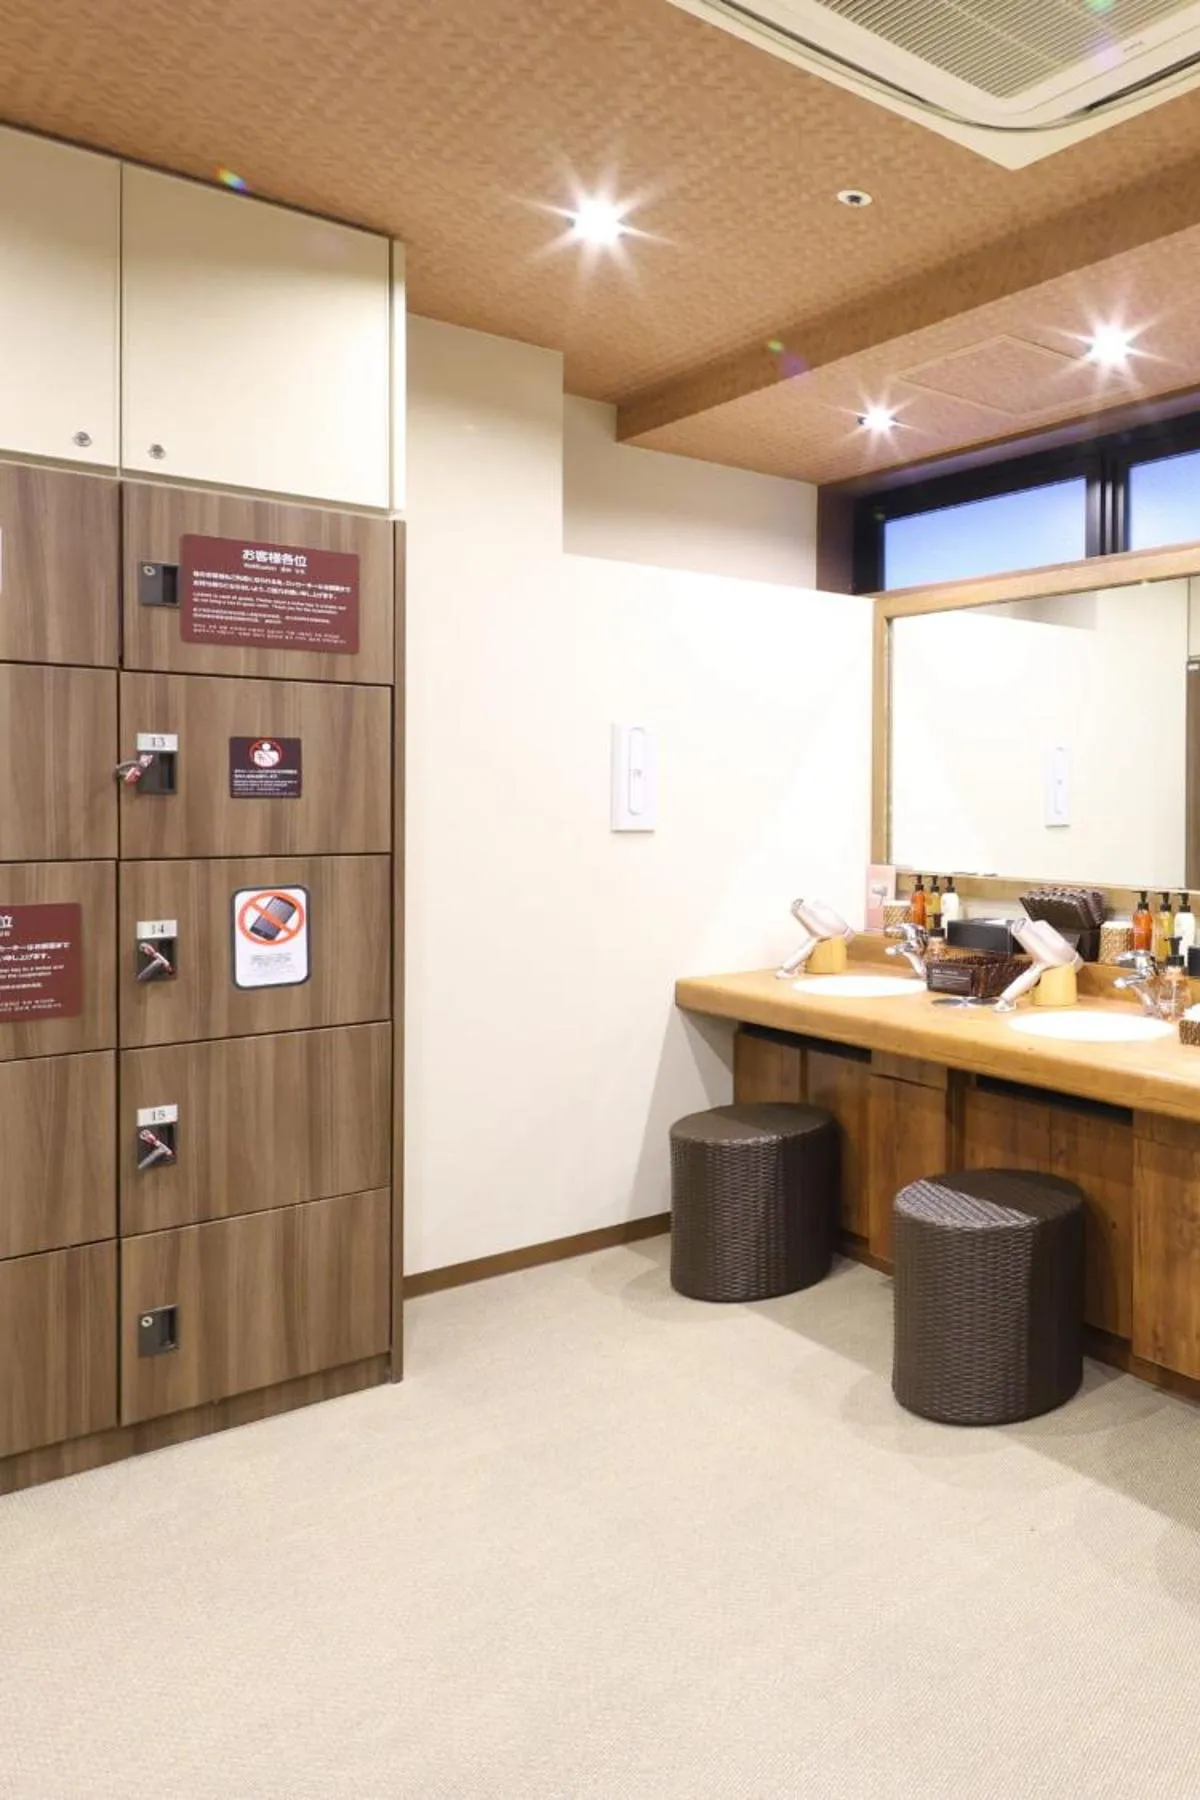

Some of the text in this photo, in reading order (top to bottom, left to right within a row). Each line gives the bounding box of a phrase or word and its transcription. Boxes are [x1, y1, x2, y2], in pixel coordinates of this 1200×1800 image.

[242, 549, 308, 567] お客様各位
